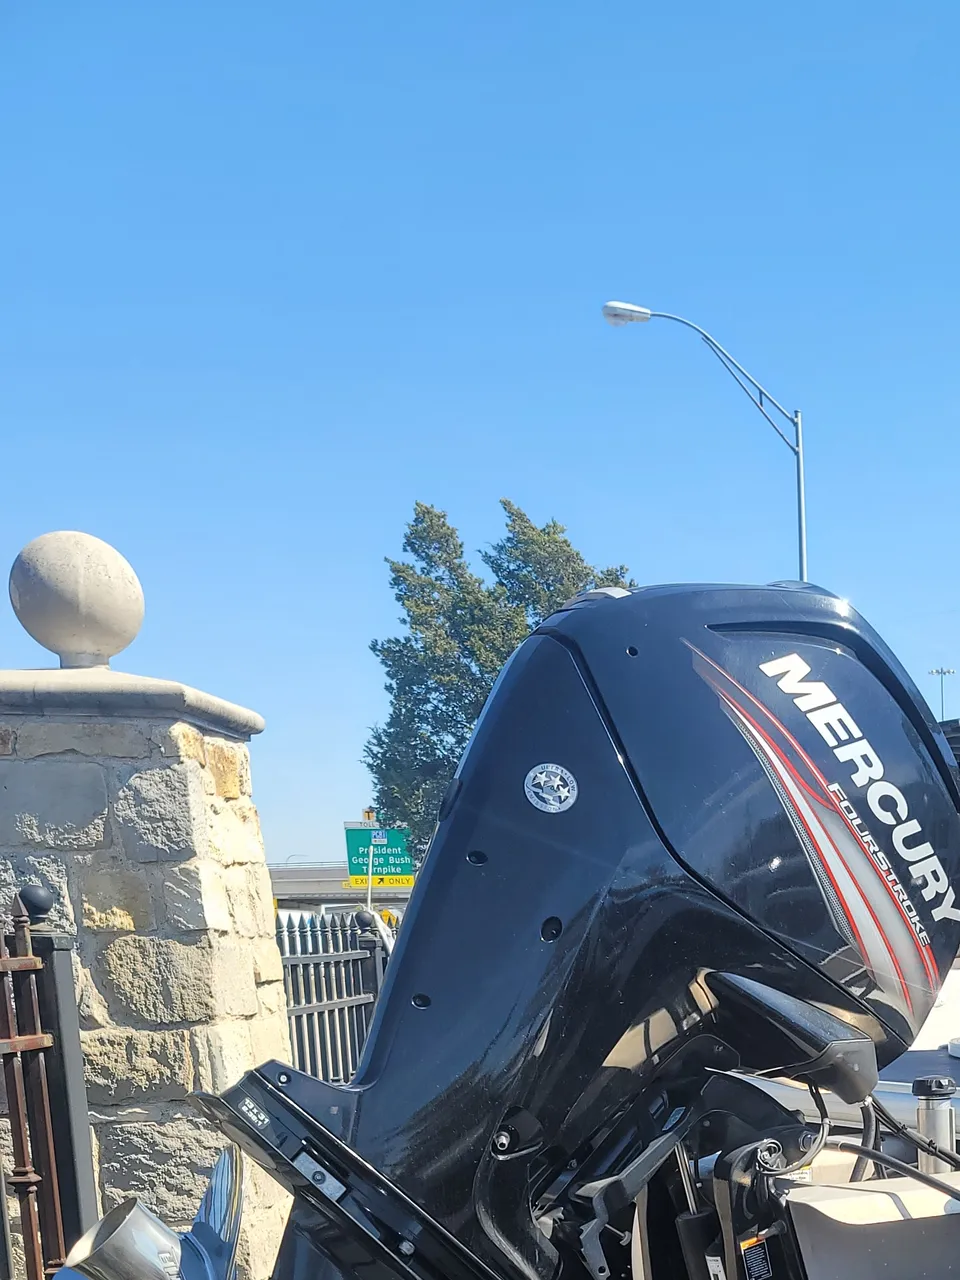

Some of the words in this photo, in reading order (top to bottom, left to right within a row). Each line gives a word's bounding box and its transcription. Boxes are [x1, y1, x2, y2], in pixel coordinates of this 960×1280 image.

[358, 846, 402, 854] Prsident
[351, 856, 384, 866] Geoge
[388, 856, 411, 864] Bush
[826, 782, 931, 947] FOURSTROKE
[362, 866, 402, 875] Trnpike
